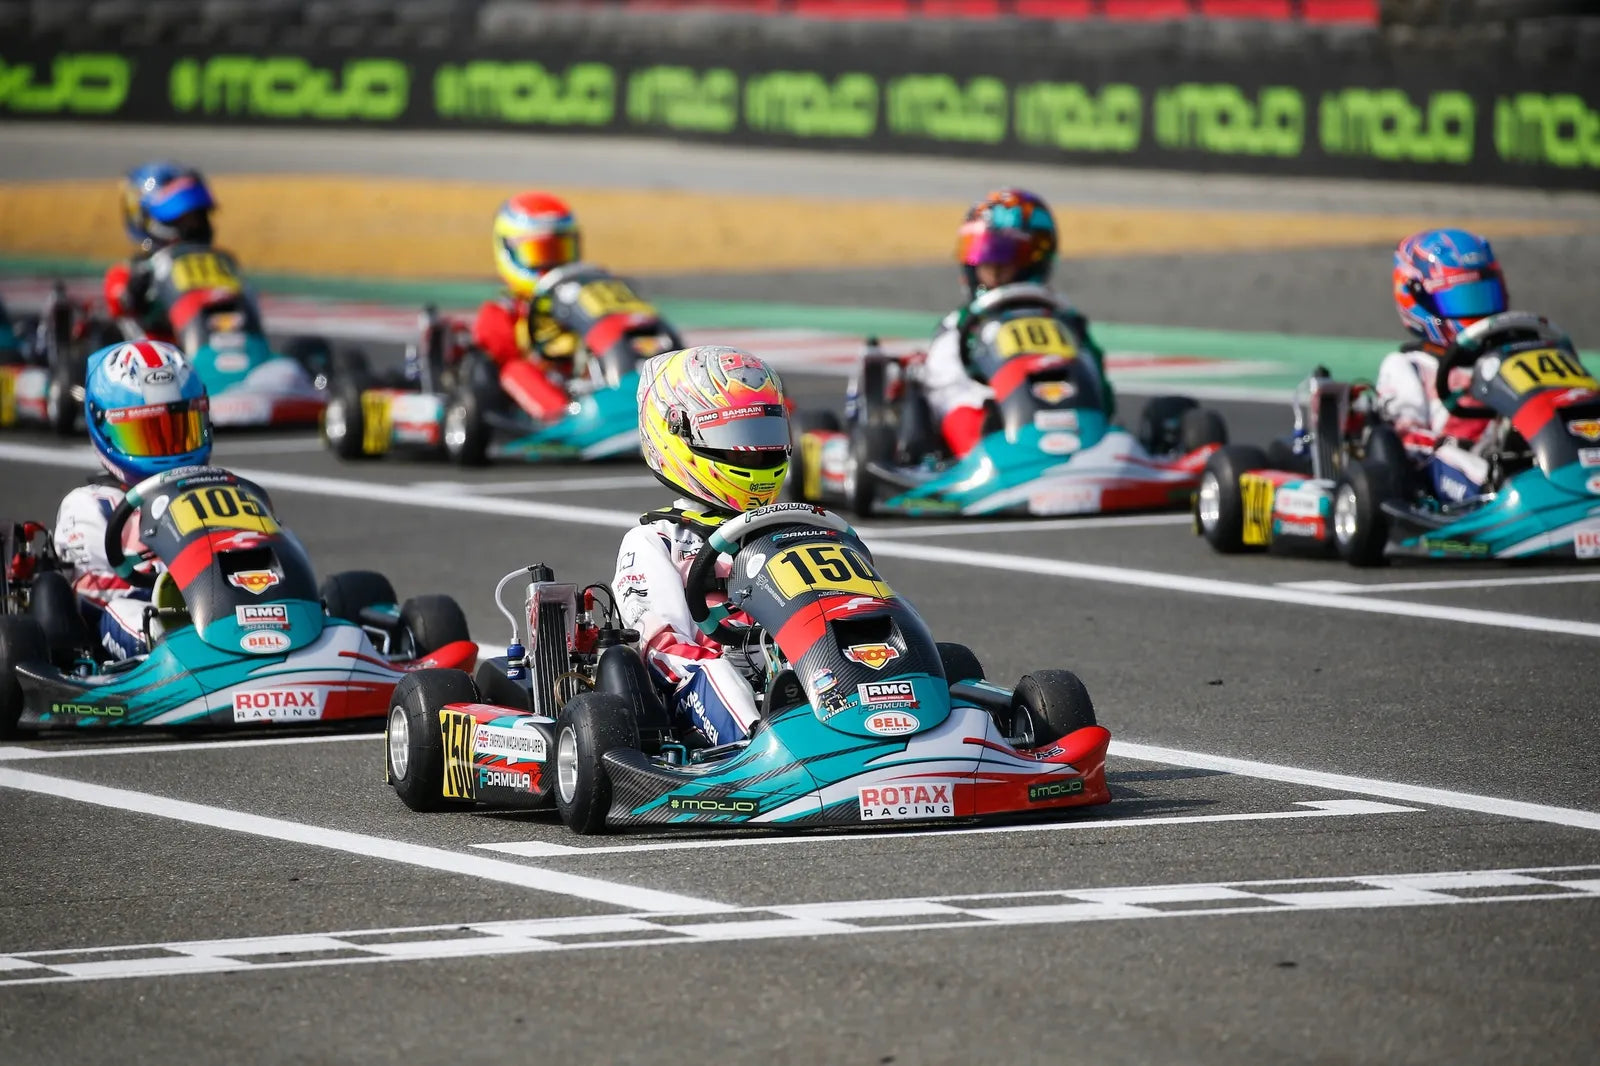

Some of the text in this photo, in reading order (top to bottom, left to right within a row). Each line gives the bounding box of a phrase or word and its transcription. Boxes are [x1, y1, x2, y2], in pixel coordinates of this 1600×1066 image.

[697, 412, 719, 423] RMC
[722, 406, 763, 417] BAHRAIN
[181, 487, 268, 521] 105
[781, 546, 883, 586] 150
[245, 607, 284, 617] RMC
[248, 637, 282, 647] BELL
[868, 684, 911, 696] RMC
[235, 691, 315, 709] ROTAX
[237, 708, 317, 719] RACING
[873, 717, 911, 729] BELL
[441, 712, 476, 798] 150
[861, 785, 949, 807] ROTAX
[863, 805, 951, 817] RACING
